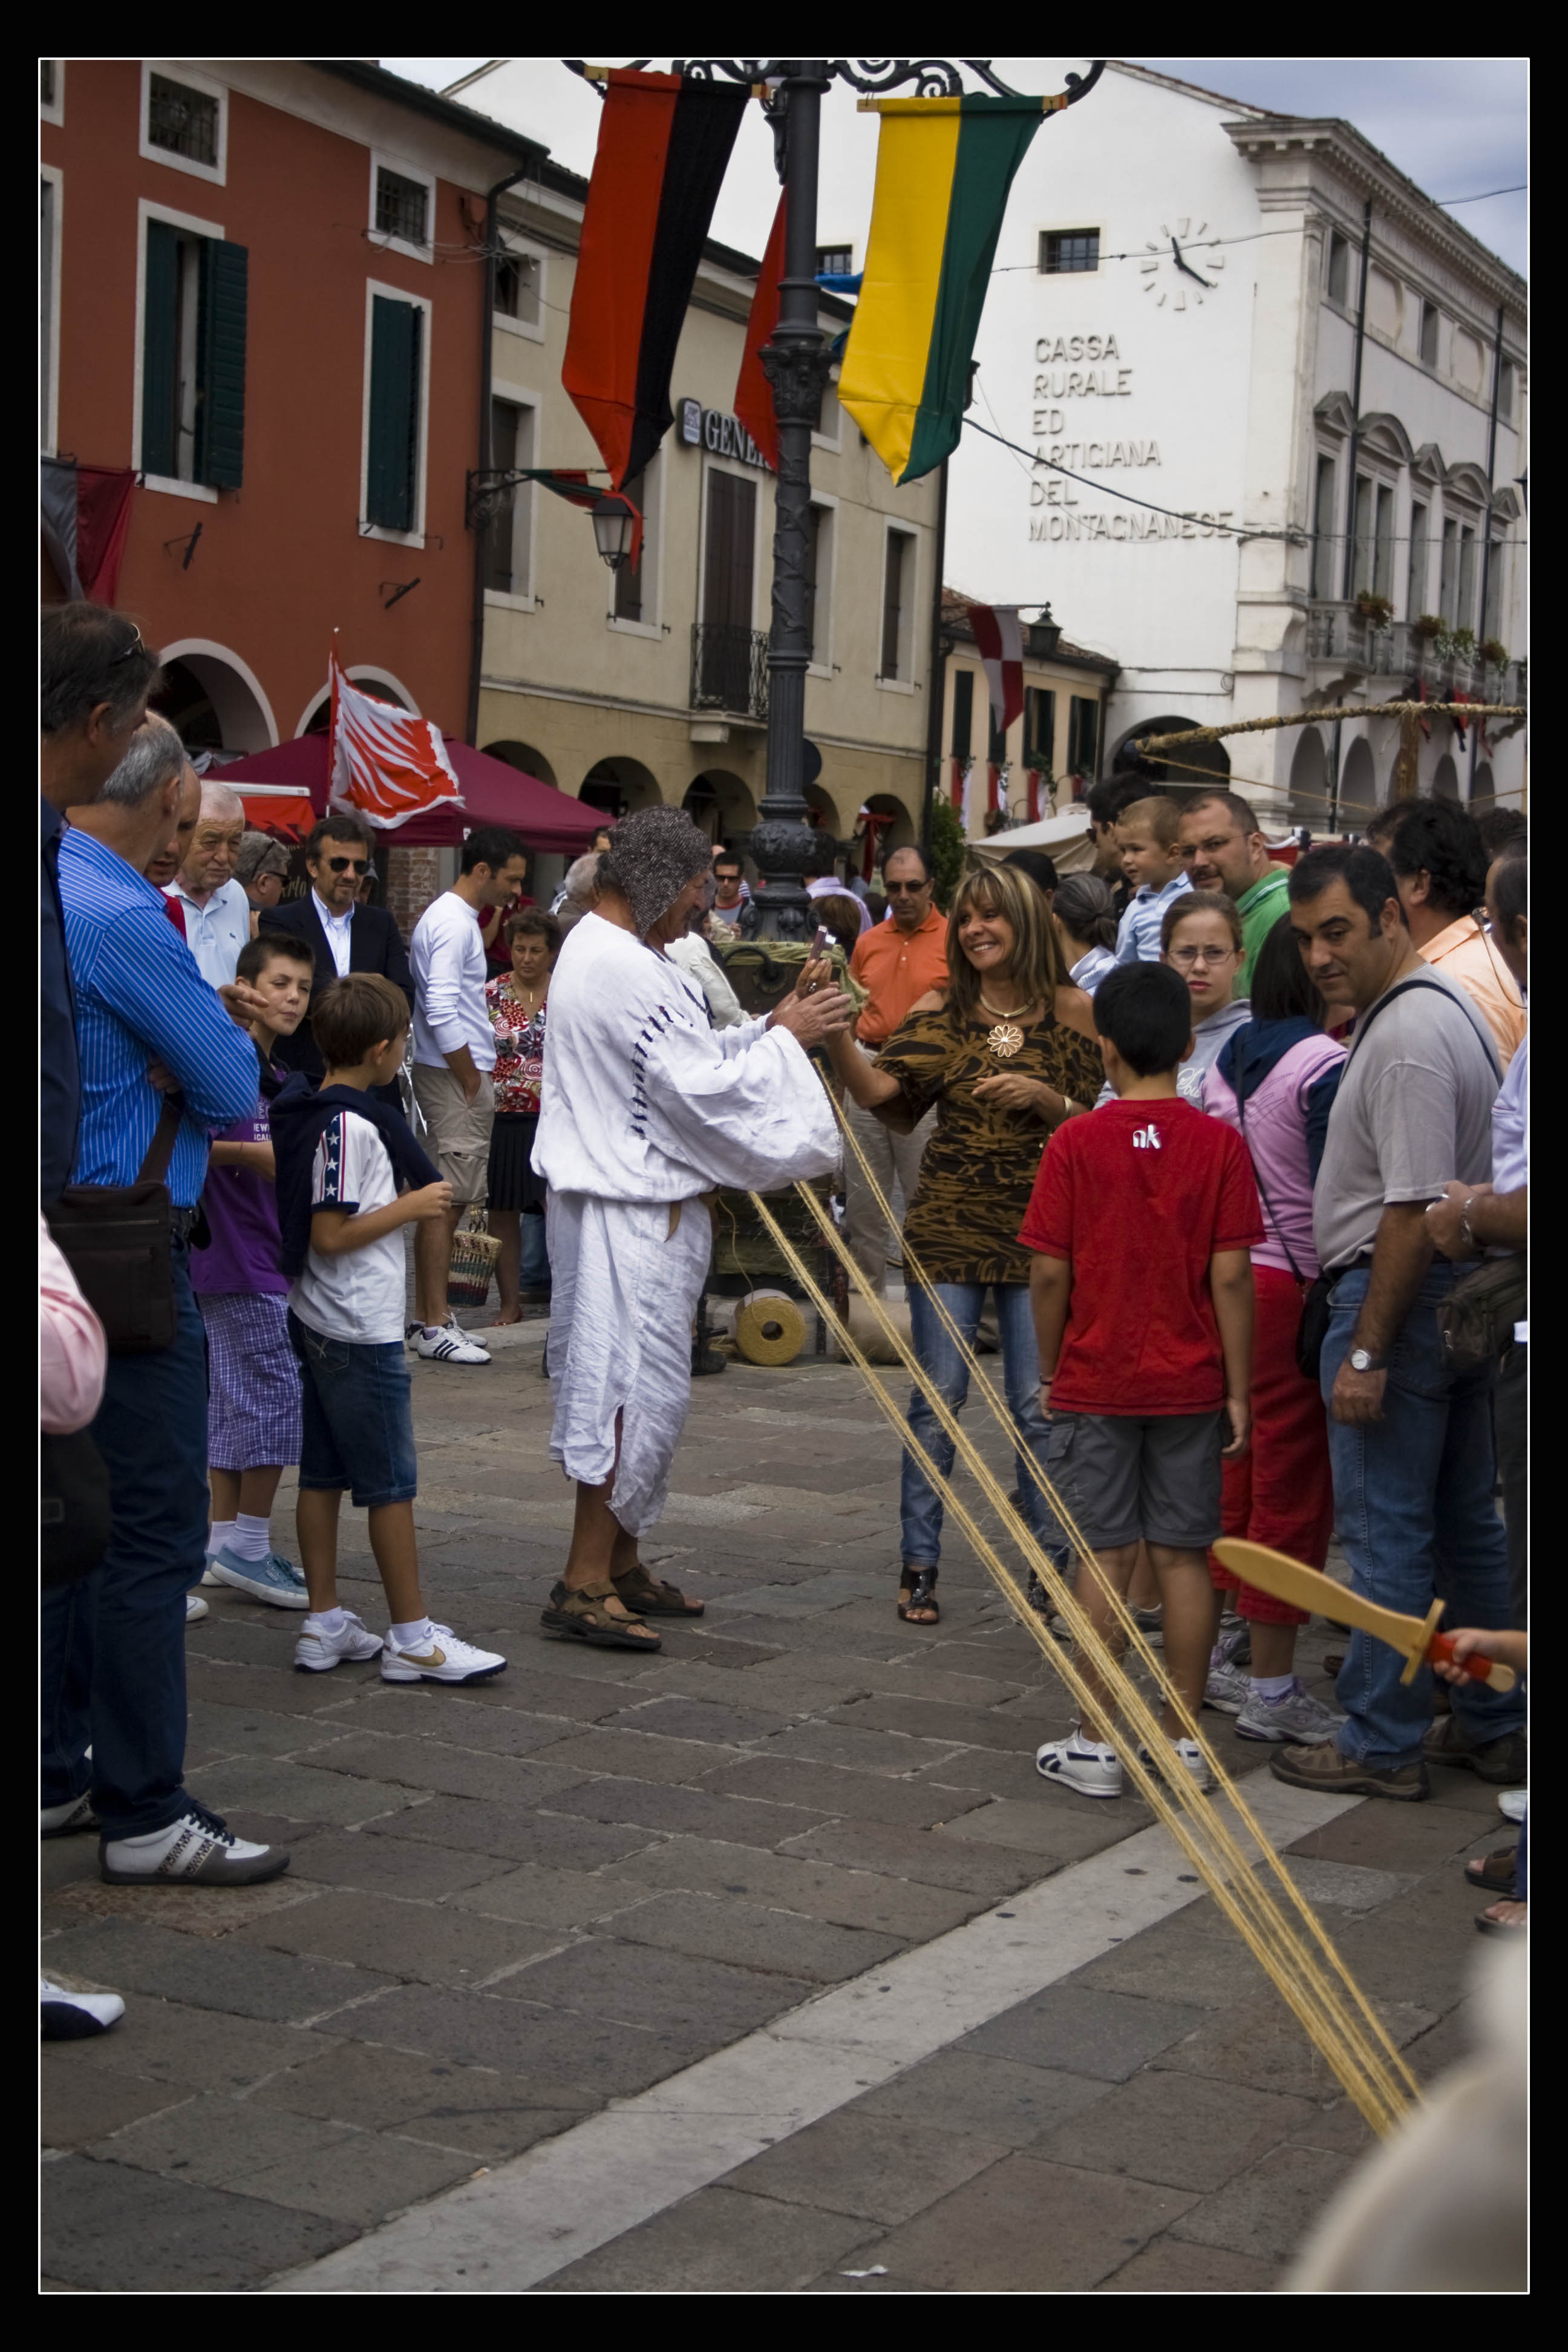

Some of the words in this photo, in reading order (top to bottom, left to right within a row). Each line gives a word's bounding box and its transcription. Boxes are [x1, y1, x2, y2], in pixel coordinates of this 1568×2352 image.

[1035, 334, 1120, 363] CASSA
[1033, 369, 1132, 399] RURALE
[1032, 410, 1064, 435] ED
[1030, 480, 1079, 506] DEL
